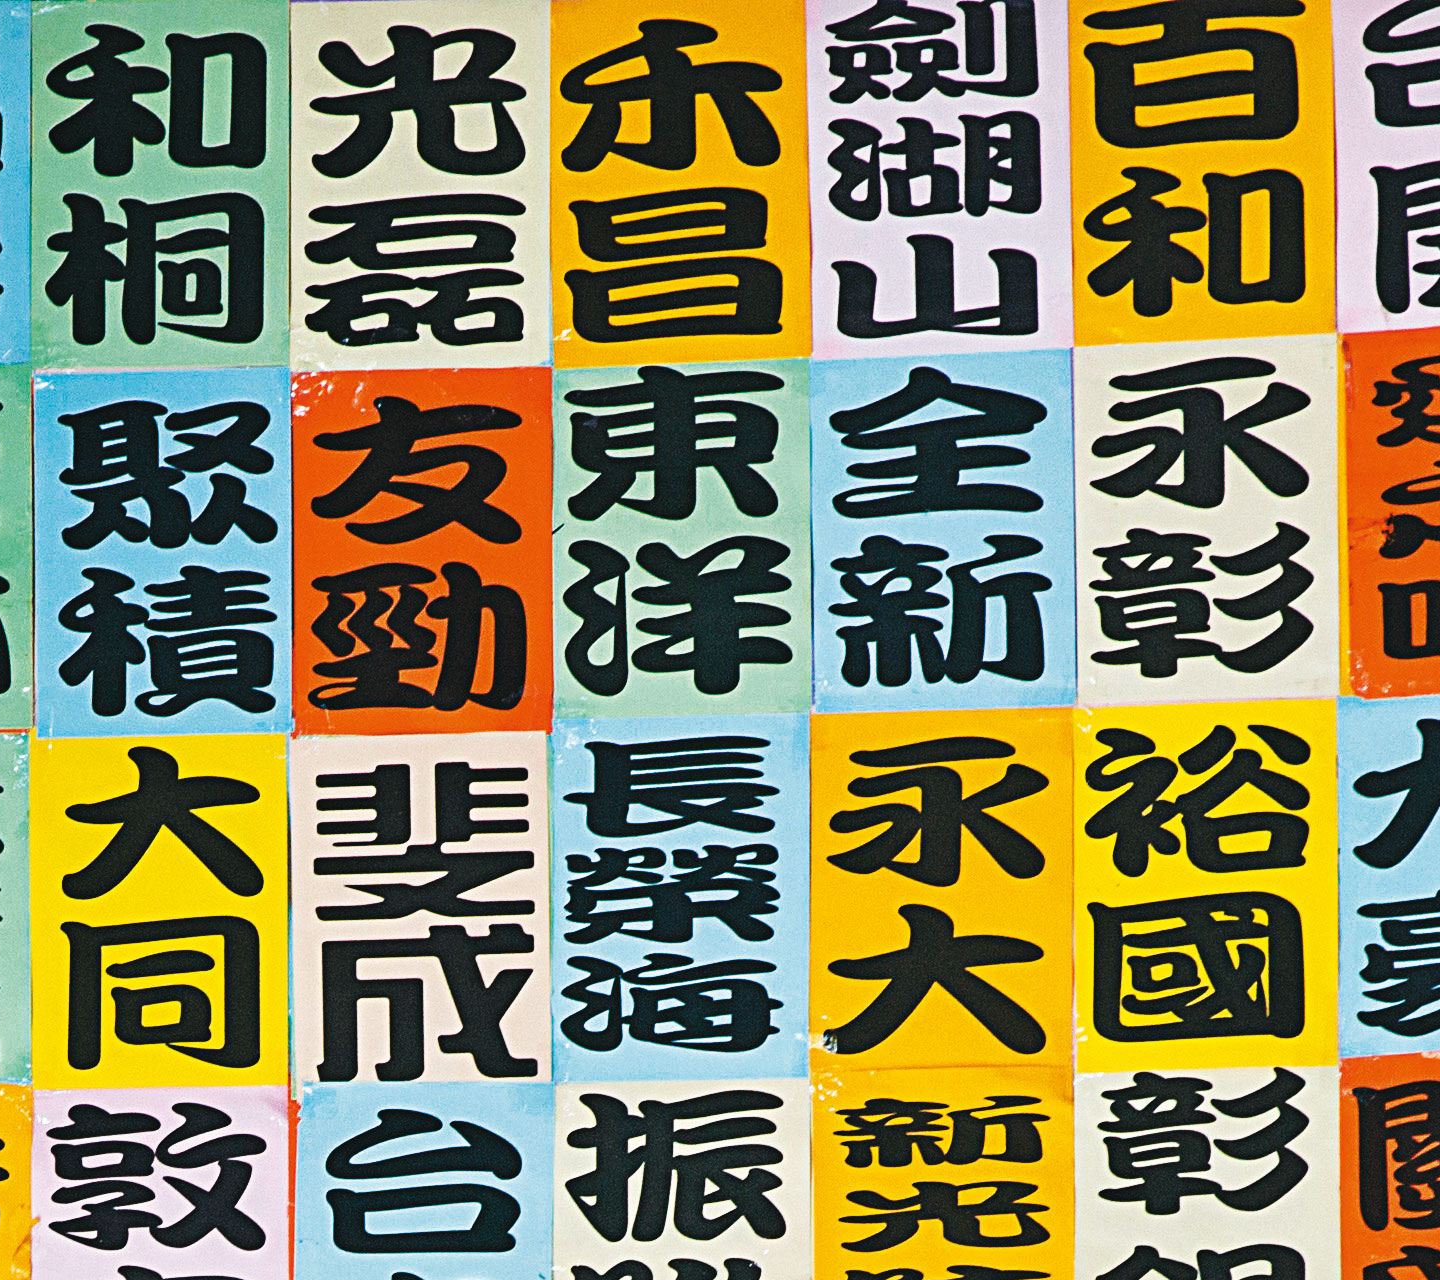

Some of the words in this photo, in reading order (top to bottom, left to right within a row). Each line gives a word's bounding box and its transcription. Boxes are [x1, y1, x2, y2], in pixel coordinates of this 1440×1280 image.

[45, 24, 266, 345] 和桐
[305, 26, 526, 346] 光磊
[825, 0, 1041, 338] 劍湖山
[1084, 0, 1305, 317] 百和
[58, 401, 277, 716] 聚積
[308, 397, 526, 711] 友勁
[563, 366, 792, 696] 東洋
[829, 368, 1051, 686] 全新
[1089, 357, 1313, 678] 永彰
[61, 747, 263, 1069] 大同
[314, 762, 537, 1081] 斐成
[561, 737, 783, 1052] 長榮海
[824, 737, 1049, 1054] 永大
[1085, 725, 1310, 1042] 裕國
